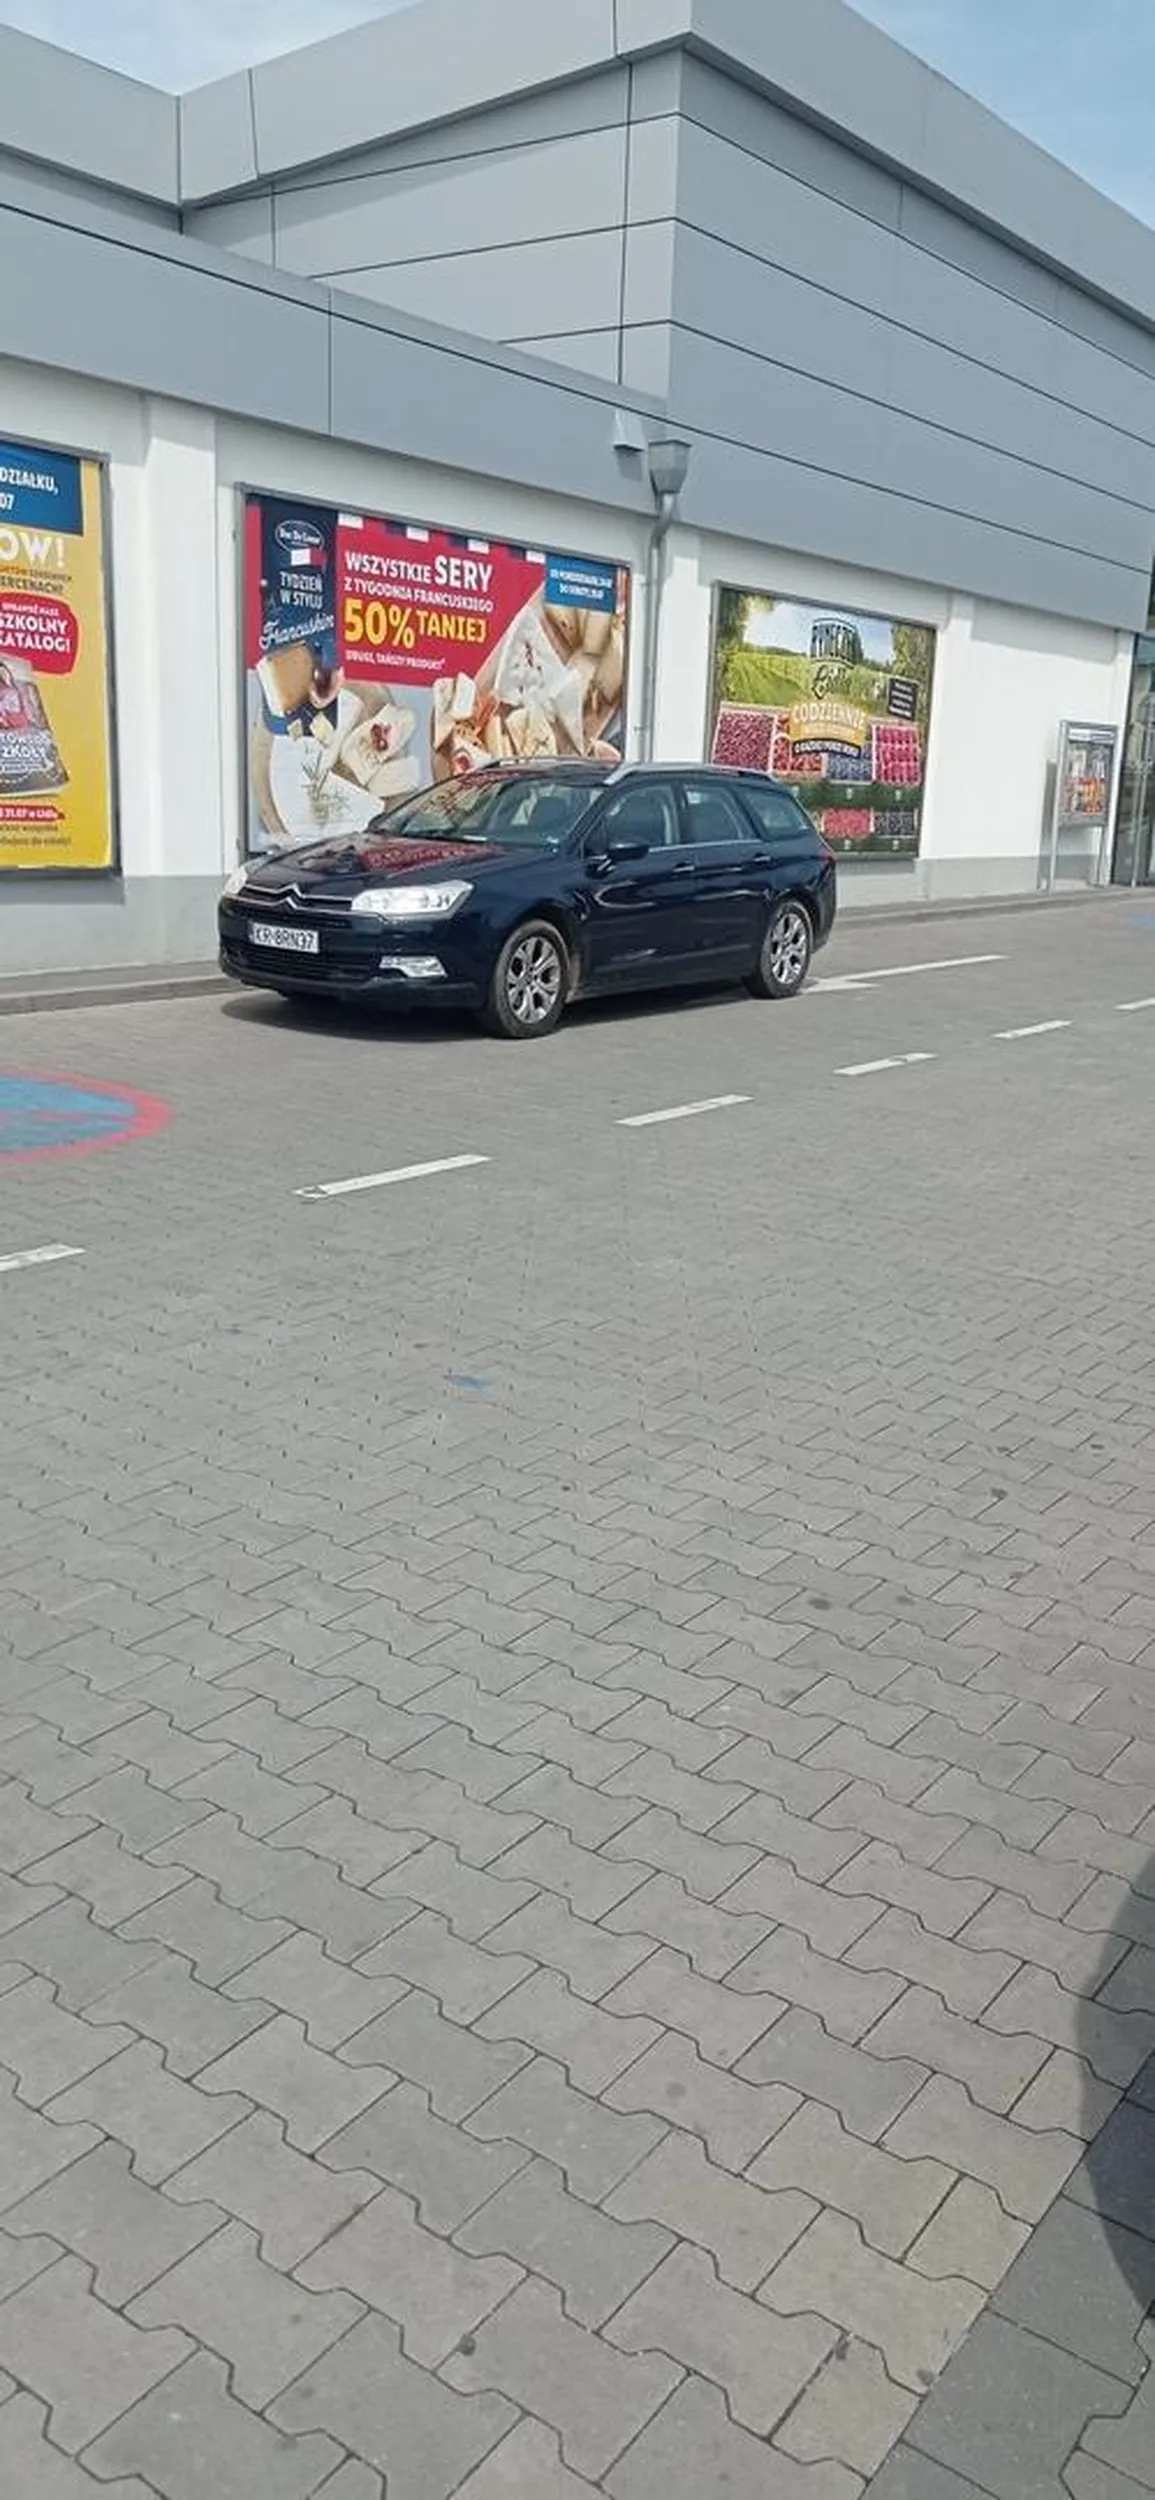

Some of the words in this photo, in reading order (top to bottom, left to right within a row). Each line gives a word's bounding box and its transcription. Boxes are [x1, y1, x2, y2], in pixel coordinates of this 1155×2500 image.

[345, 551, 432, 584] WSZYSTKIE
[434, 555, 492, 593] SERY
[280, 590, 291, 604] W
[293, 591, 323, 610] STYLU
[344, 577, 353, 591] Z
[354, 578, 412, 601] TYGODNIA
[414, 589, 494, 613] FRANCUSKIEGO
[344, 597, 415, 649] 50%
[416, 610, 487, 644] TANIEJ
[793, 702, 866, 731] CODZIENNIE
